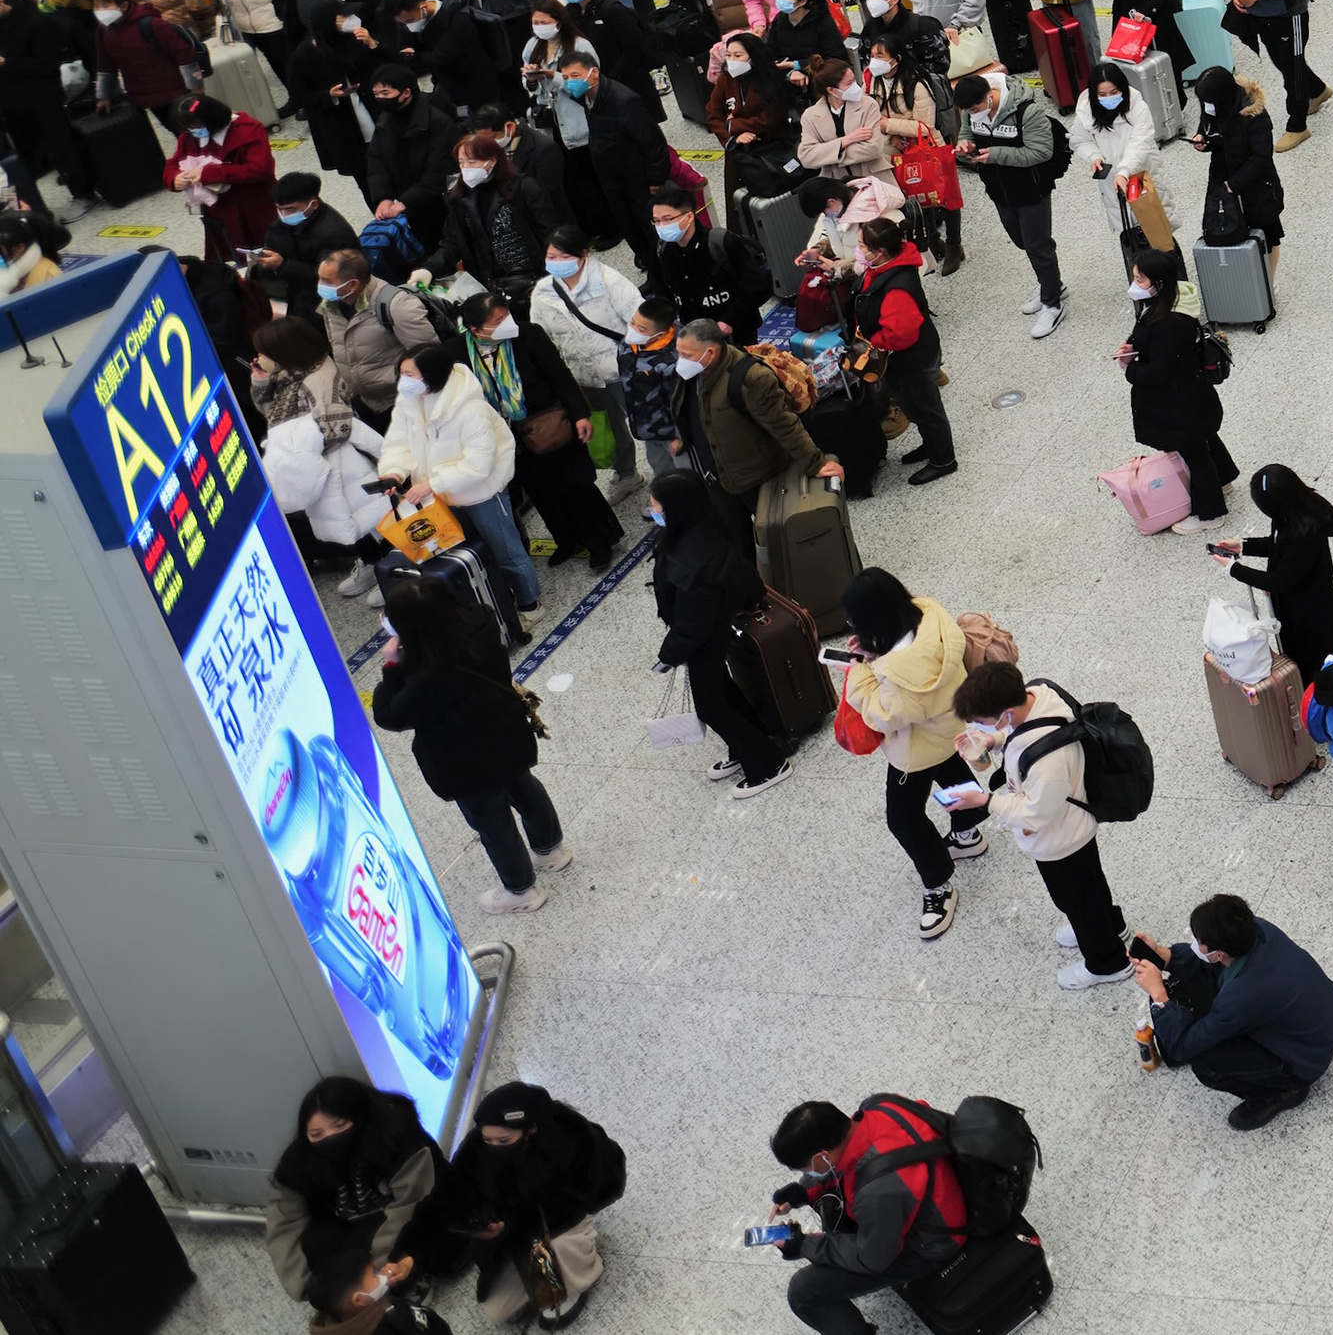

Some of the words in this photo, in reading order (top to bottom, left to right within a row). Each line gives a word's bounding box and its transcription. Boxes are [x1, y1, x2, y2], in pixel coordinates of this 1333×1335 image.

[94, 351, 131, 407] 检票口
[125, 310, 157, 358] Check
[152, 294, 166, 319] in
[106, 312, 212, 525] A12
[196, 549, 271, 710] 真正天然
[215, 601, 290, 758] 矿泉水
[347, 863, 404, 977] Ganten
[362, 836, 401, 915] 百岁山
